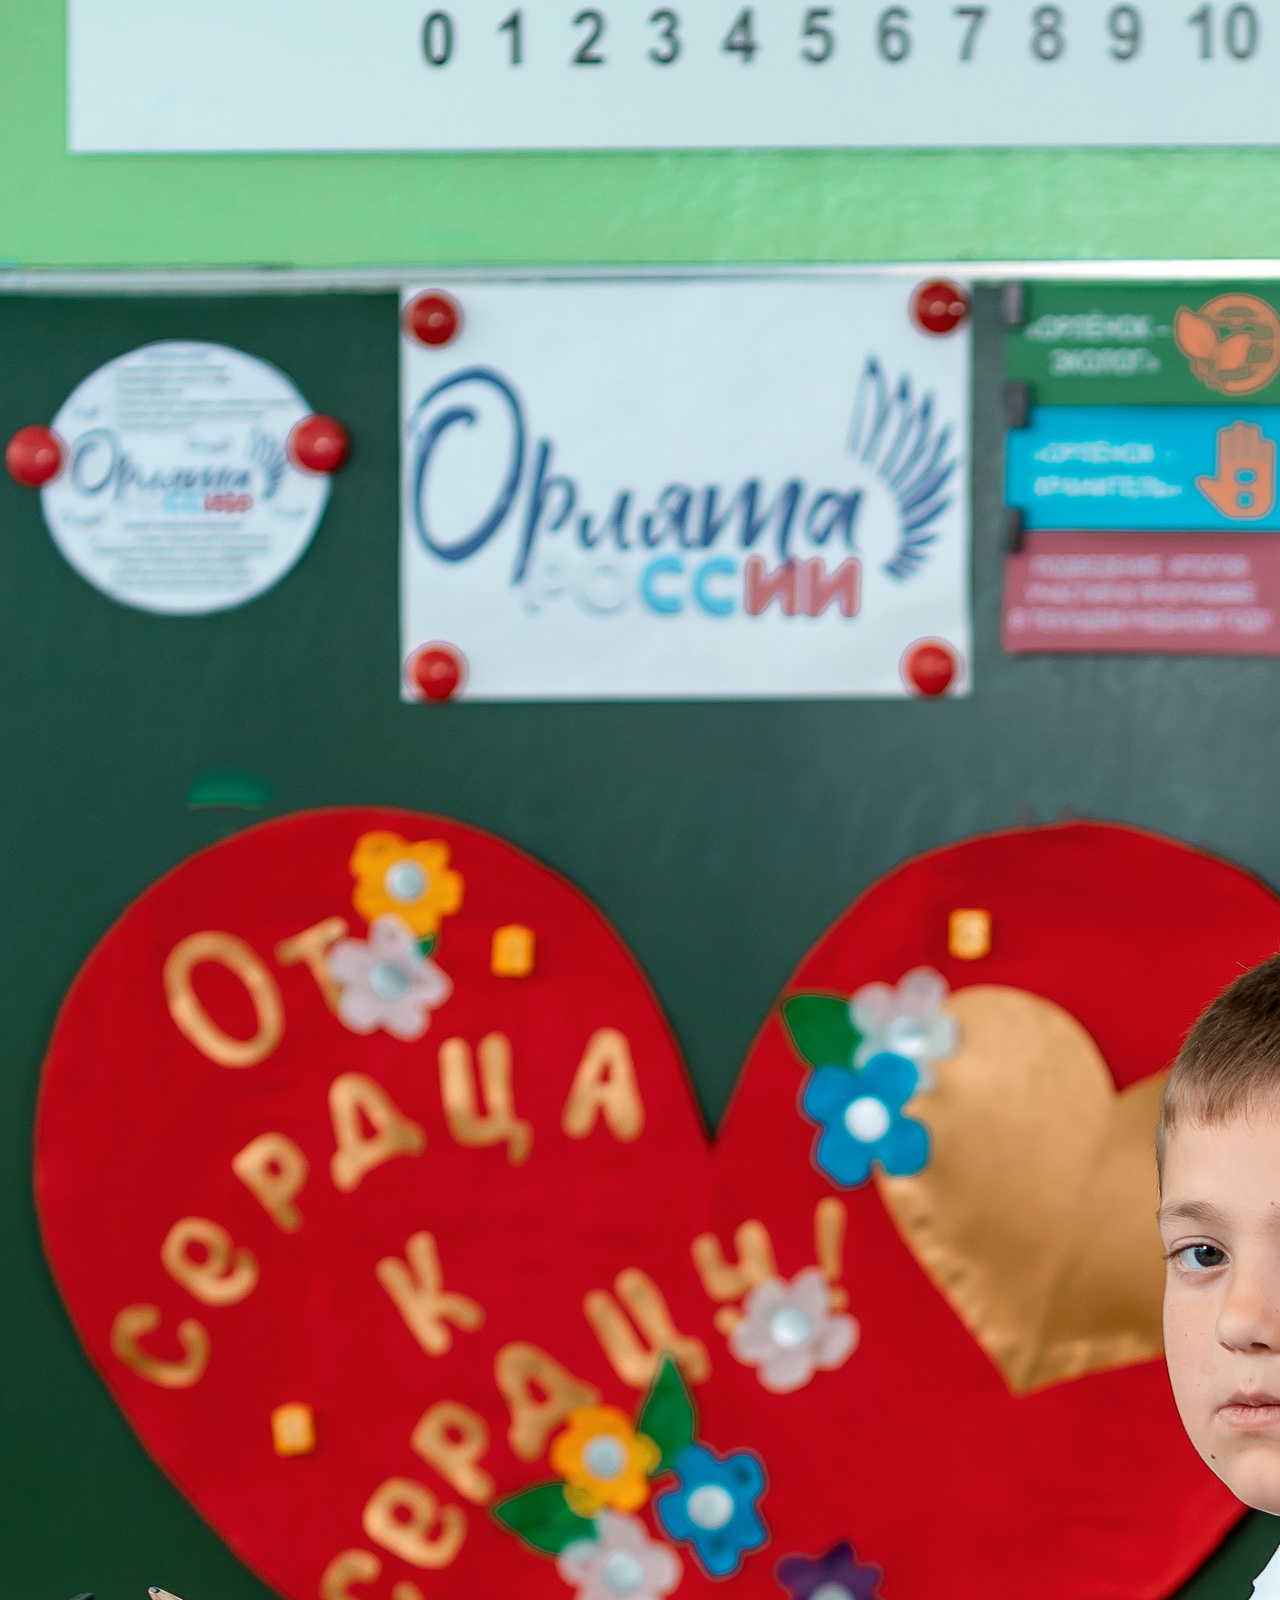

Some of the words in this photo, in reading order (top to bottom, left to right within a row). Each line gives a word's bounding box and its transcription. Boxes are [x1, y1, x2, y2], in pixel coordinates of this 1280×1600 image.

[421, 10, 455, 67] 0
[499, 8, 522, 66] 1
[571, 8, 606, 66] 2
[648, 7, 682, 65] 3
[721, 6, 759, 63] 4
[801, 7, 835, 64] 5
[876, 5, 911, 63] 6
[953, 4, 989, 62] 7
[1030, 3, 1066, 62] 8
[1106, 3, 1143, 62] 9
[1187, 2, 1260, 61] 10
[410, 364, 862, 586] Орлята
